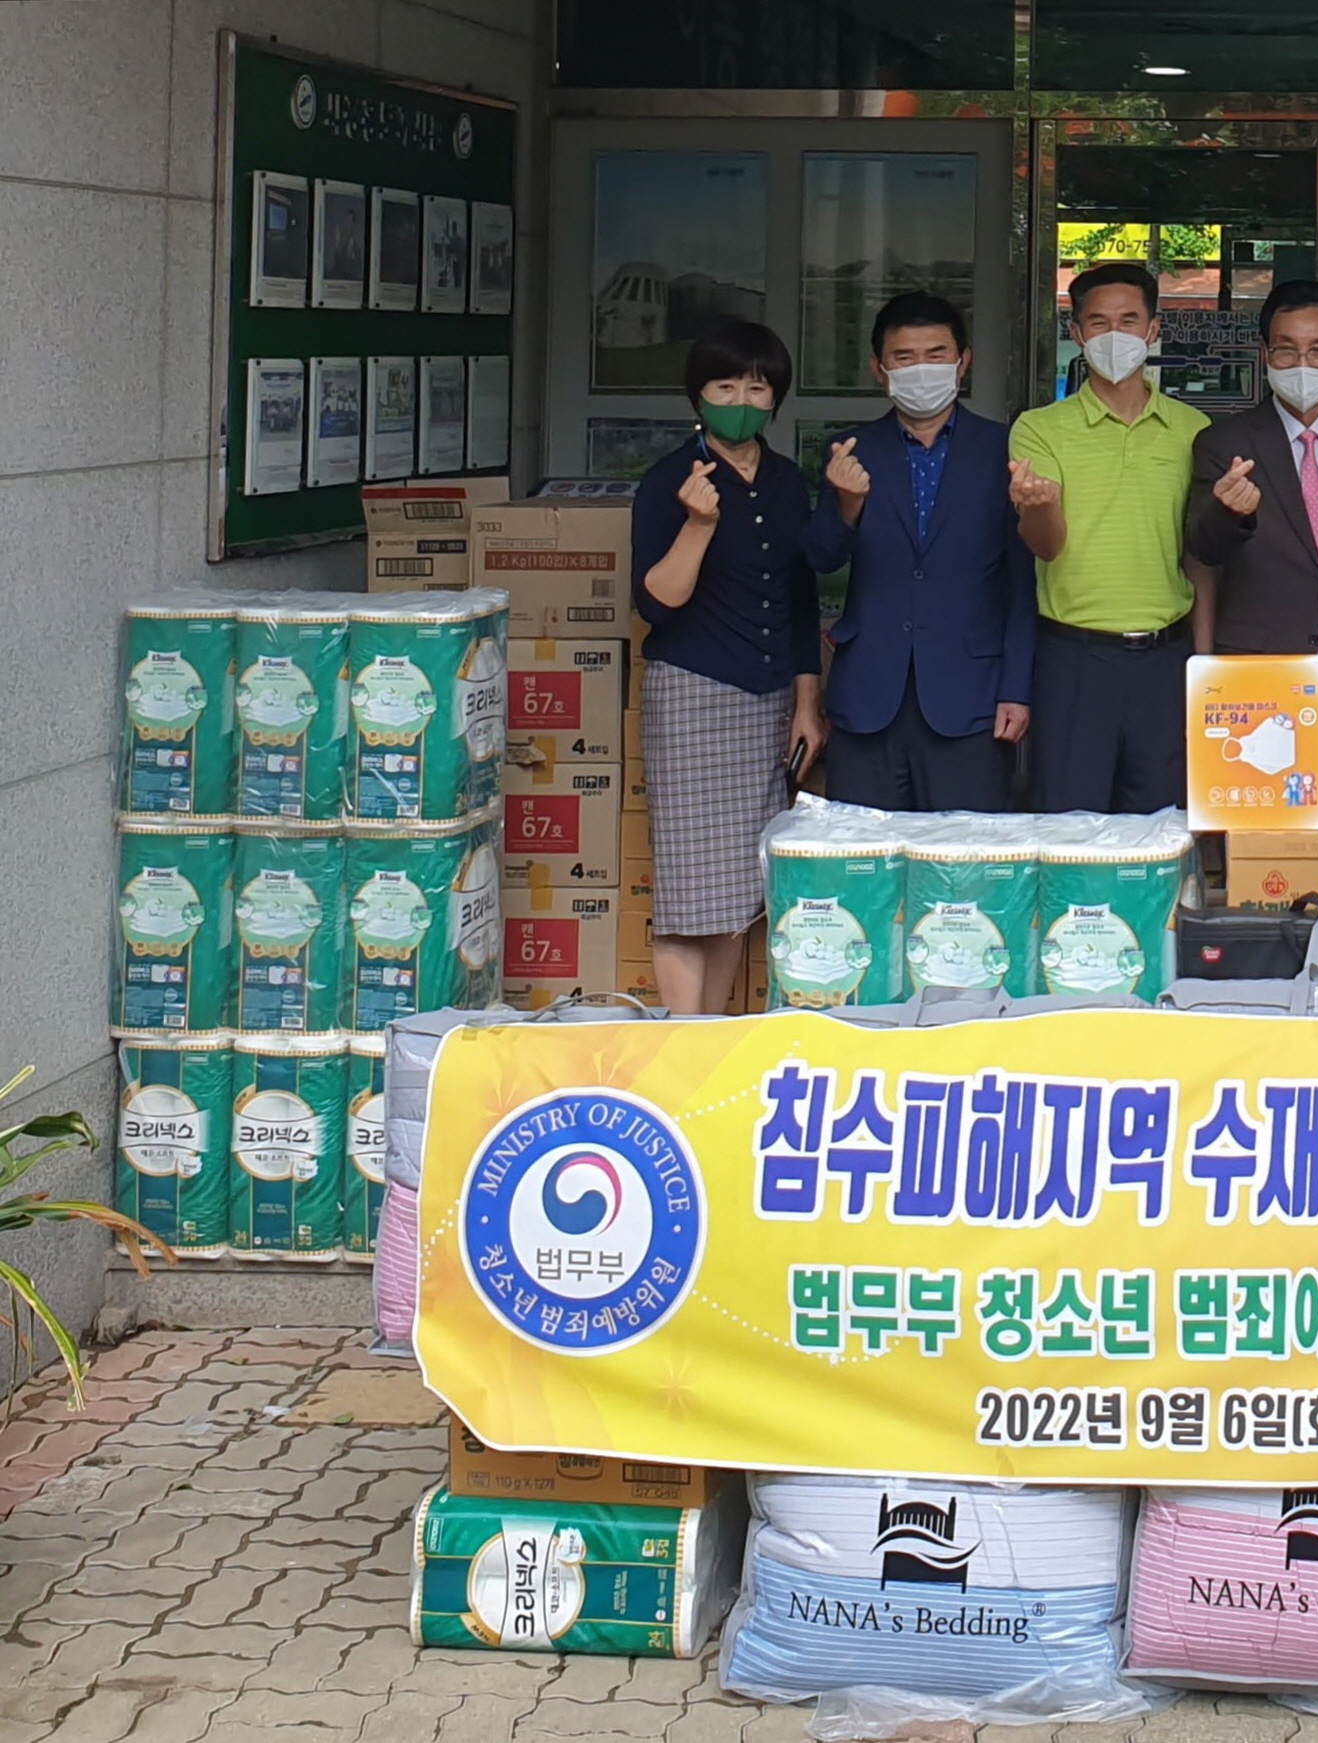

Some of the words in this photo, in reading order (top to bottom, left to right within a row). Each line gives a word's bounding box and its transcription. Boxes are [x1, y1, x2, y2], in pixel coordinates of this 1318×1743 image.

[523, 692, 566, 714] 67호
[1205, 712, 1248, 724] KF-94
[572, 738, 586, 754] 4
[521, 816, 564, 838] 67호
[570, 862, 585, 879] 4
[520, 940, 562, 962] 67호
[124, 1121, 196, 1139] 크리넥스
[239, 1126, 311, 1144] 크리넥스
[760, 1066, 1171, 1221] 침수피해지역
[479, 1103, 580, 1198] MINISTRY
[588, 1103, 627, 1130] OF
[619, 1116, 691, 1214] JUSTICE
[536, 1248, 624, 1283] 법무부
[793, 1269, 956, 1352] 법무부
[980, 1274, 1150, 1357] 청소년
[980, 1393, 1122, 1445] 2022년
[1140, 1393, 1204, 1447] 9월
[514, 1537, 538, 1638] 크리넥스
[1188, 1576, 1309, 1615] NANA's
[788, 1592, 903, 1633] NANA's
[648, 1631, 664, 1648] 24
